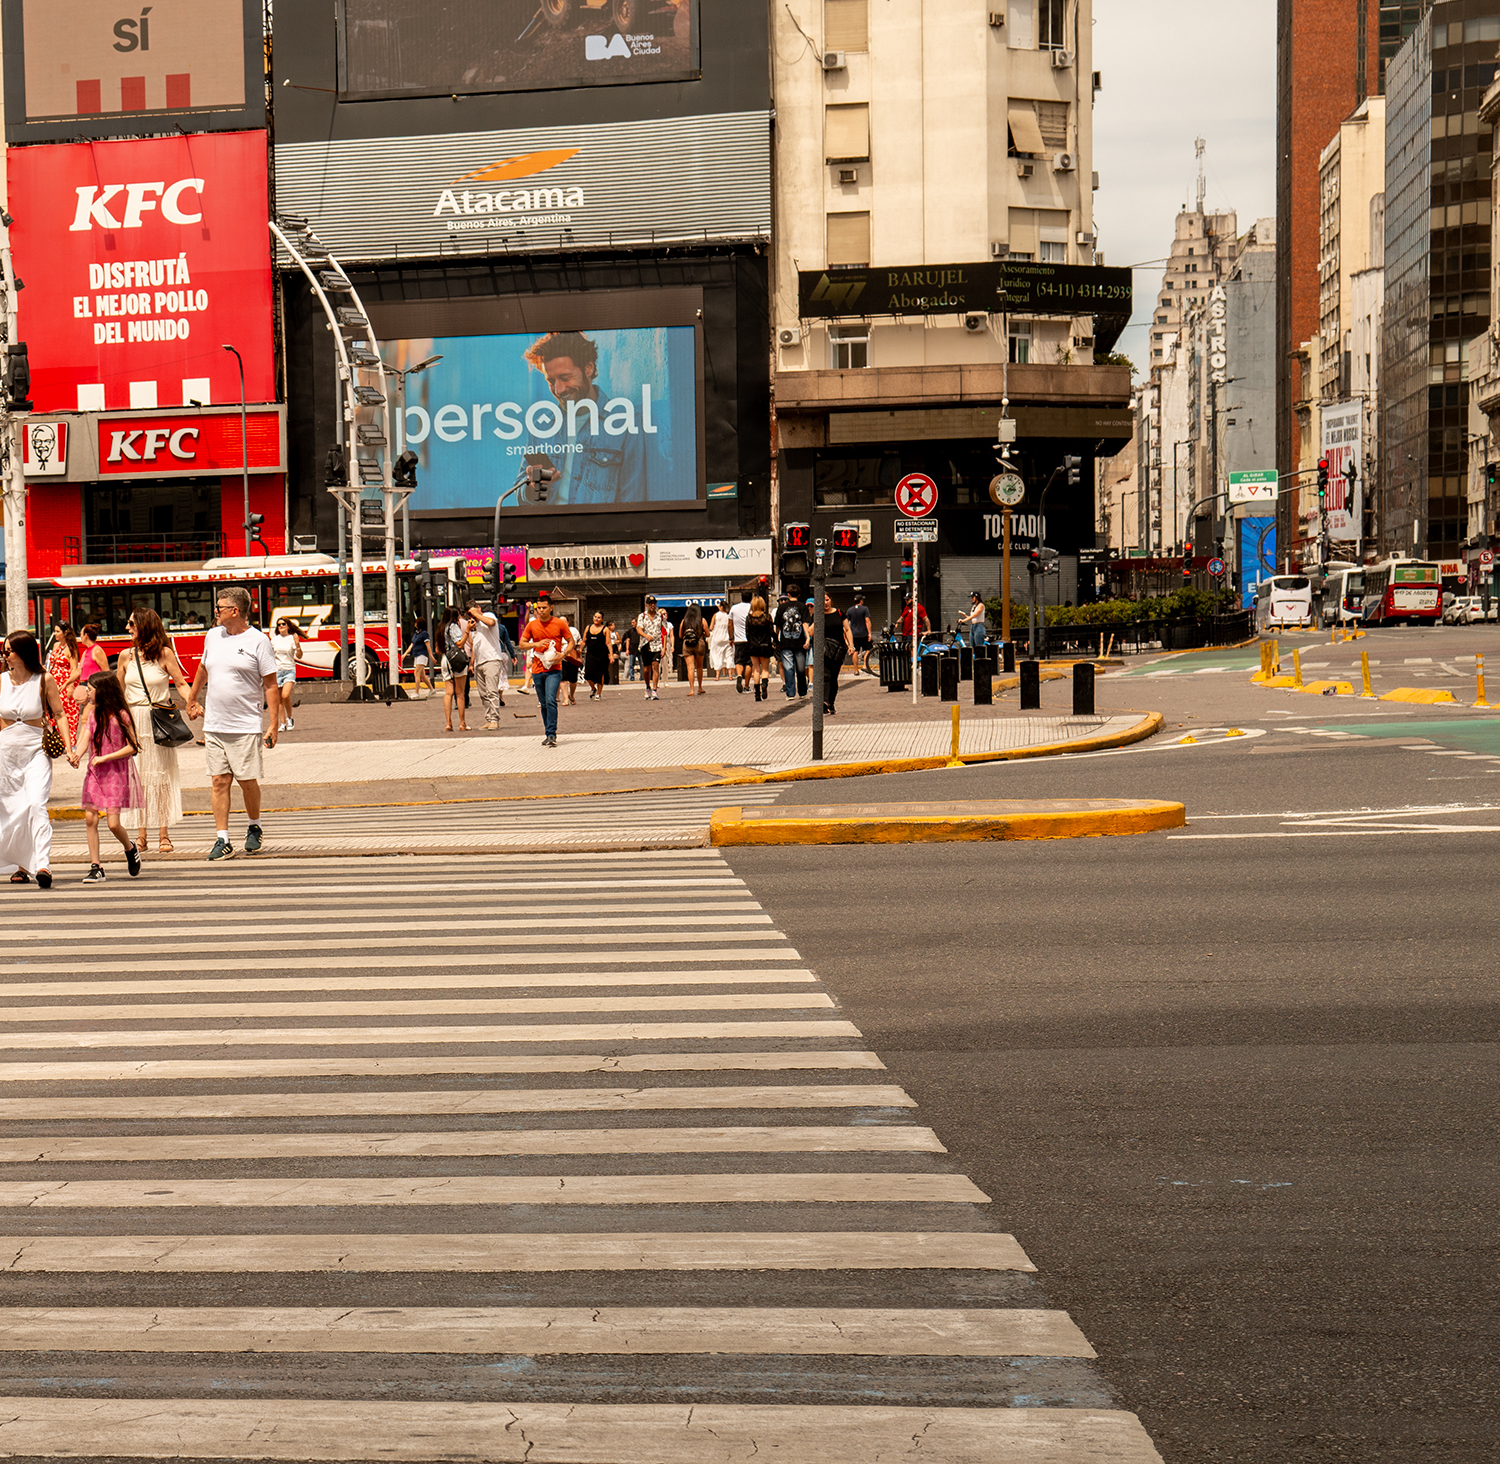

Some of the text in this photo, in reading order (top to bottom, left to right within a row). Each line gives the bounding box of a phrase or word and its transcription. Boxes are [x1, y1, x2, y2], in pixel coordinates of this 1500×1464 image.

[585, 33, 631, 60] BA
[633, 46, 661, 55] Ciudad
[69, 178, 205, 231] KFC
[433, 186, 584, 216] Atacama
[447, 213, 571, 230] Buenos Aires, Argentina
[89, 252, 190, 289] DISFRUTÁ
[1000, 263, 1055, 275] Asesoramiento
[888, 270, 968, 288] BARUJEL
[1037, 282, 1132, 299] (54-11) 4314-2939
[73, 289, 208, 318] EL MEJOR POLLO
[888, 291, 965, 310] Abogados
[93, 318, 189, 344] DEL MUNDO
[1211, 285, 1227, 385] ASTROS
[396, 384, 657, 455] personal
[106, 427, 199, 462] KFC
[505, 441, 584, 457] smarthome
[997, 541, 1013, 550] CAÉ
[546, 555, 627, 571] LOVE CHUKA
[86, 574, 199, 586] TRANSPORTES
[208, 572, 237, 580] DEL
[245, 570, 293, 578] TEJAR
[301, 568, 332, 576] S.A.
